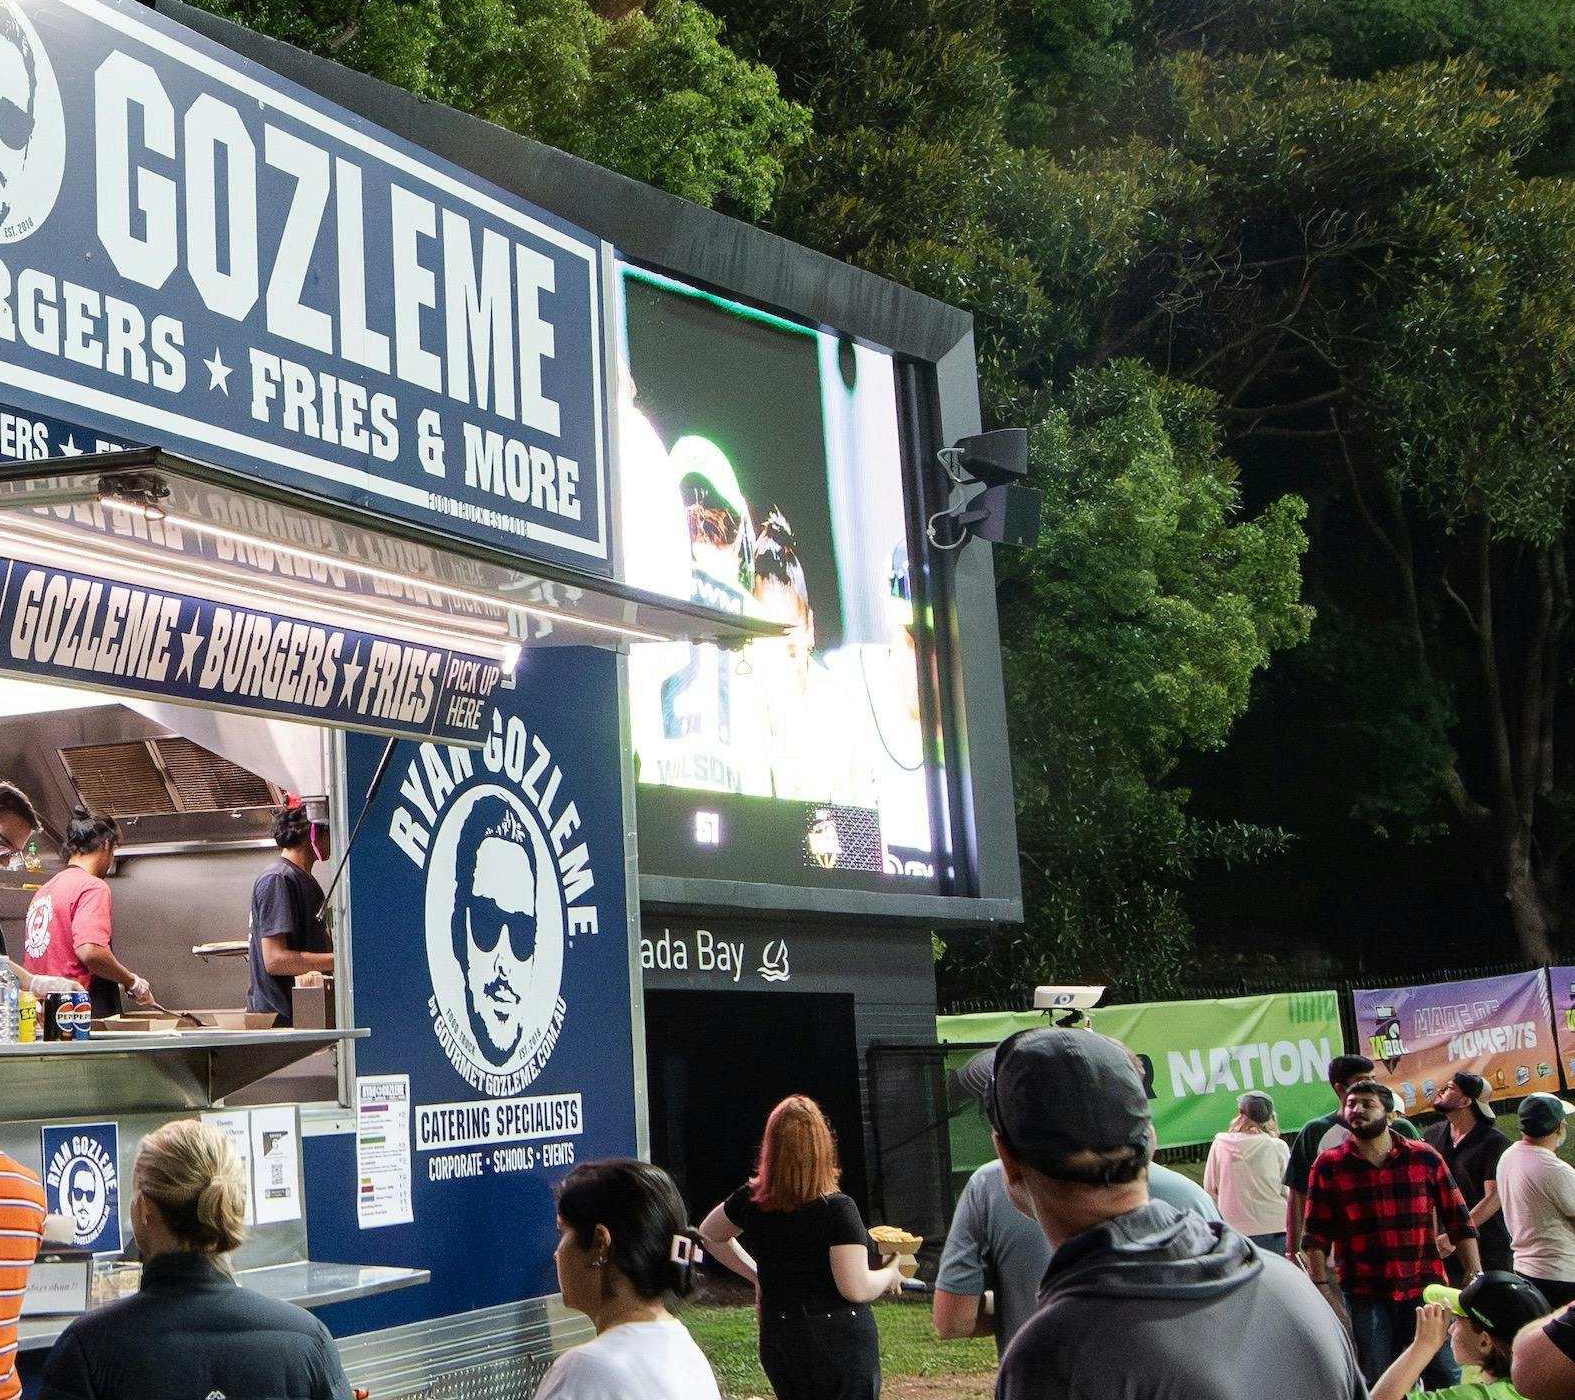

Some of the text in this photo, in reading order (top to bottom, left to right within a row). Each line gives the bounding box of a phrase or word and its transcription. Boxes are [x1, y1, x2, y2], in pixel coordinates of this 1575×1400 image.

[17, 216, 34, 234] 2018
[94, 50, 564, 438] GOZLEME
[250, 348, 399, 461] FRIES
[417, 410, 445, 477] &
[464, 424, 582, 521] MORE
[9, 568, 443, 726] GOZLEME BURGERS FRIES
[446, 656, 501, 694] PICK UP
[445, 695, 486, 732] HERE
[657, 753, 743, 796] WILSON
[389, 707, 599, 937] RYAN GOZLEME
[697, 929, 745, 983] Bay
[1414, 1003, 1474, 1039] MADE
[1448, 1021, 1538, 1063] MOMENTS
[1167, 1037, 1331, 1098] NATION
[421, 1100, 579, 1144] CATERING SPECIALISTS
[46, 1135, 118, 1195] RYAN GOZLEME
[428, 1141, 575, 1182] CORPORATE SCHOOLS EVENTS
